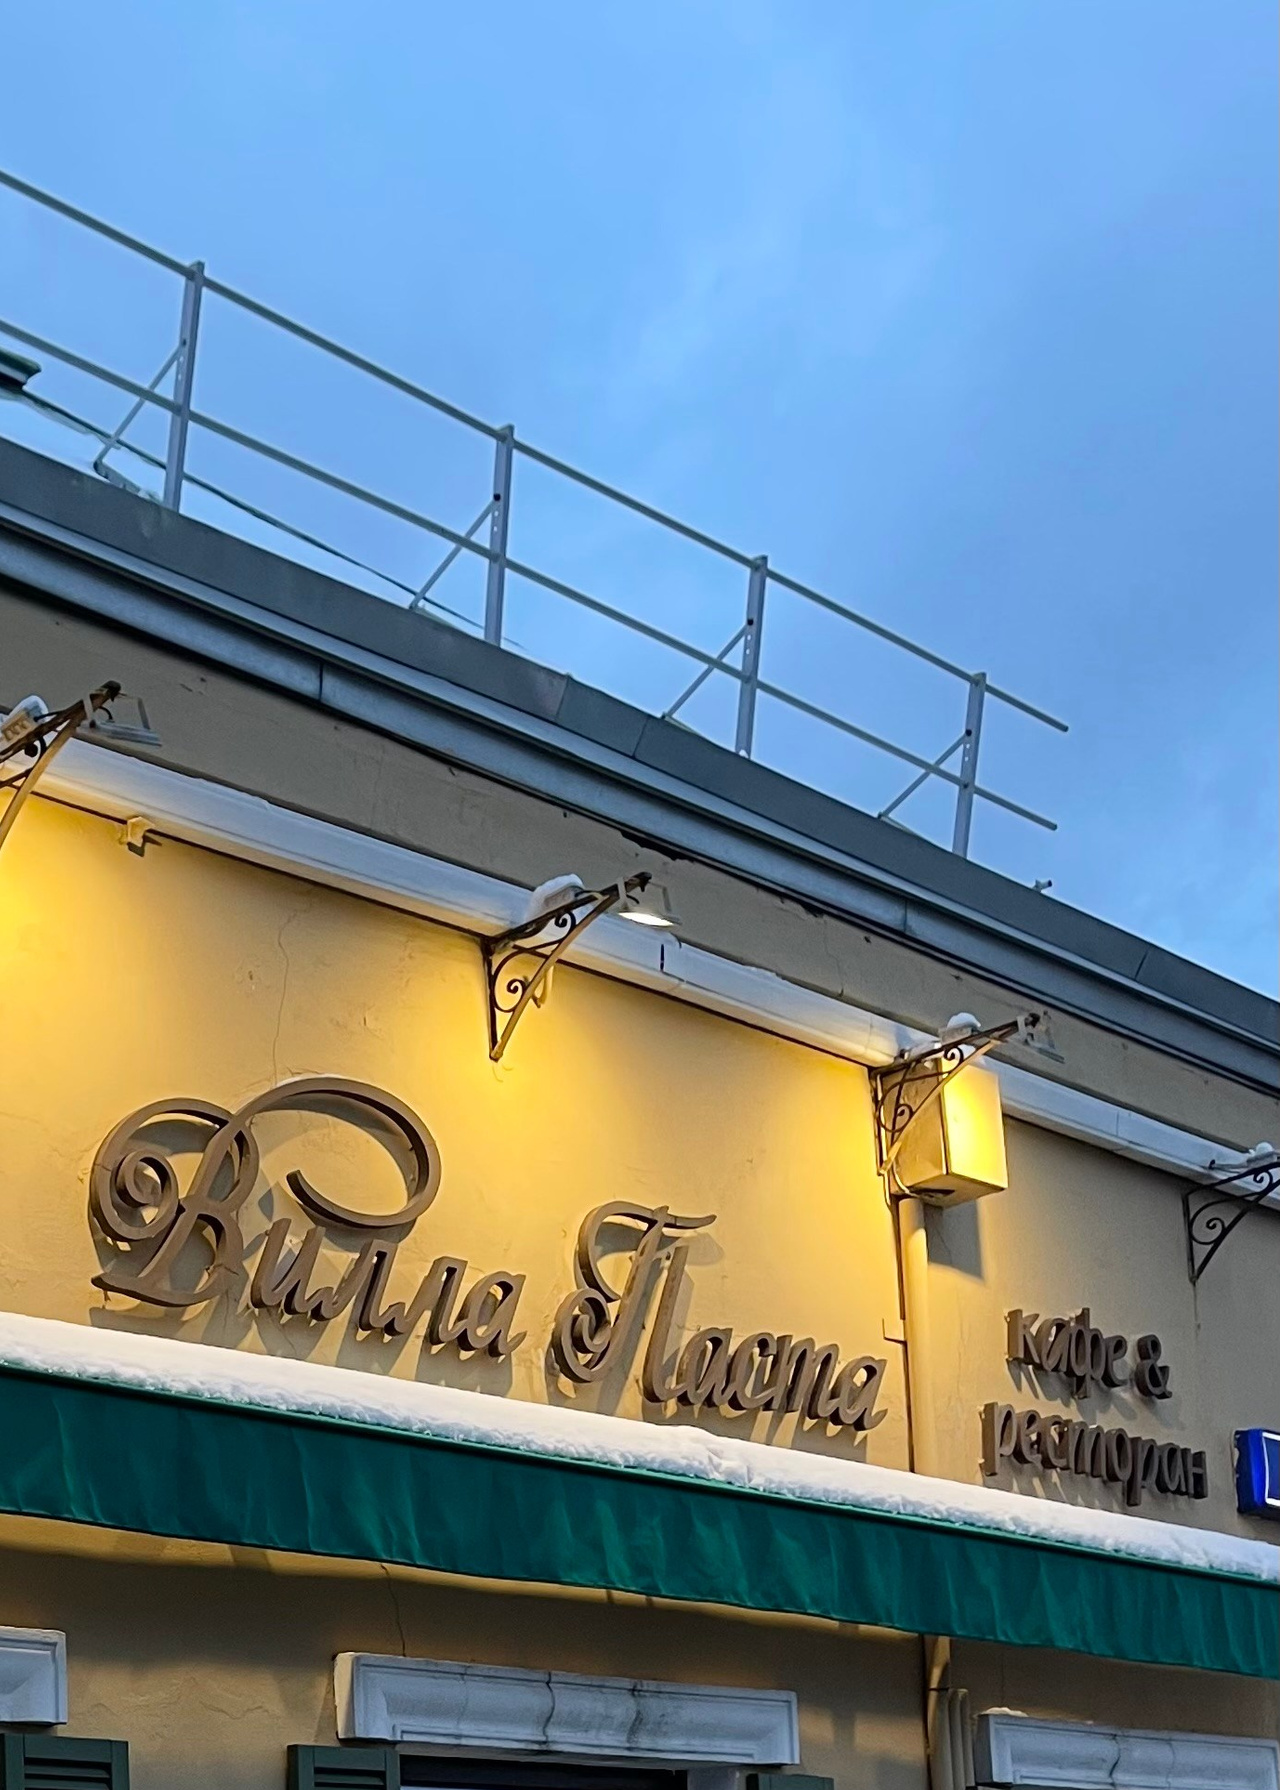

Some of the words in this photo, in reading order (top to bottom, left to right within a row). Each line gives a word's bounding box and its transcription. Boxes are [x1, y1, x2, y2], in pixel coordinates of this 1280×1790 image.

[89, 1075, 528, 1359] Вилла
[552, 1200, 888, 1432] Паста
[1004, 1307, 1128, 1399] кафе
[1134, 1333, 1172, 1400] &
[980, 1402, 1208, 1506] ресторан
